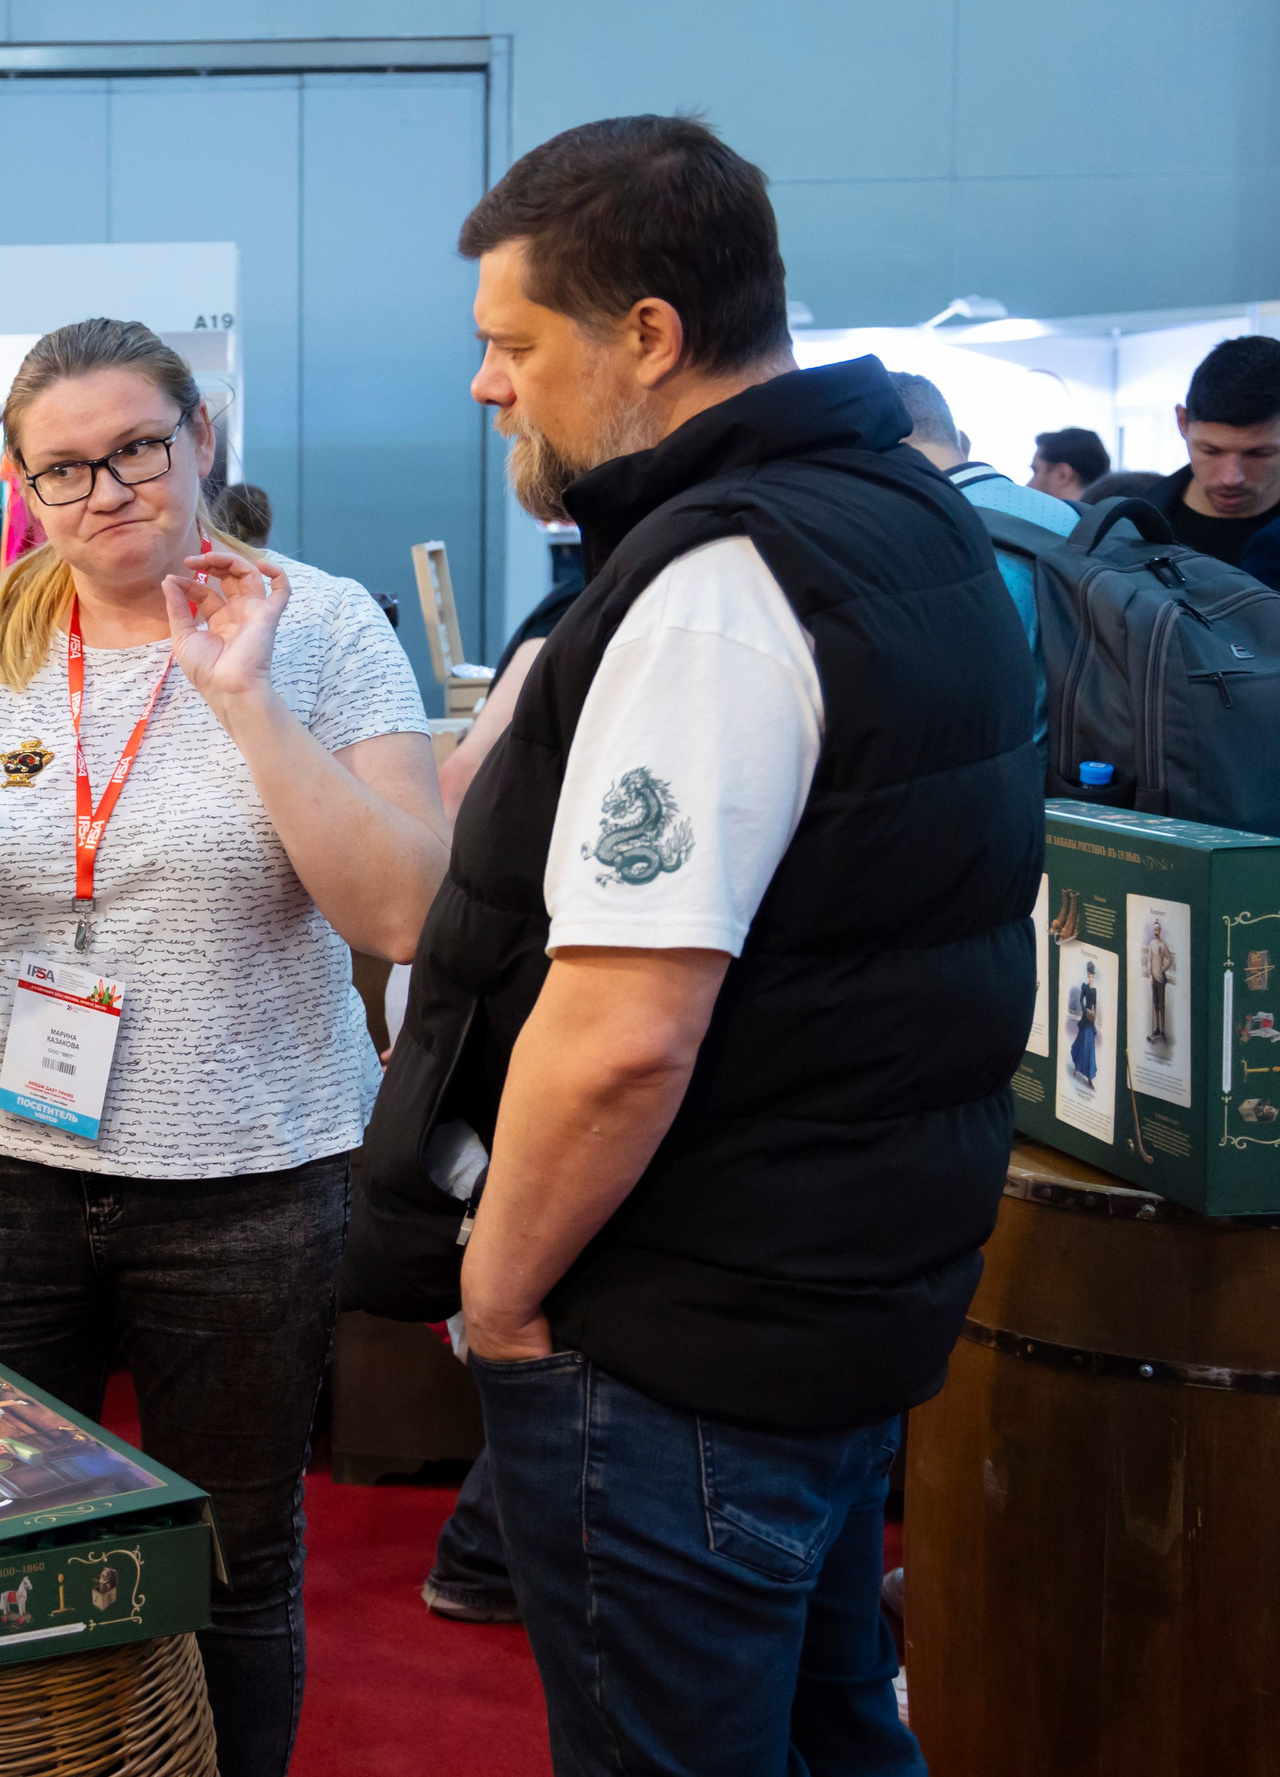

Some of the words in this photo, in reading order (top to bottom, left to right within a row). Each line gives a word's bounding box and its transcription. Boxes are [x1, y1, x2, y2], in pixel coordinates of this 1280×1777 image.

[194, 313, 233, 329] A19
[50, 1028, 77, 1041] МАРИНА
[46, 1036, 80, 1050] КАЗАКОВА
[16, 1096, 79, 1123] ПОСЕТИТЕЛЬ
[34, 1111, 58, 1123] VISITOR
